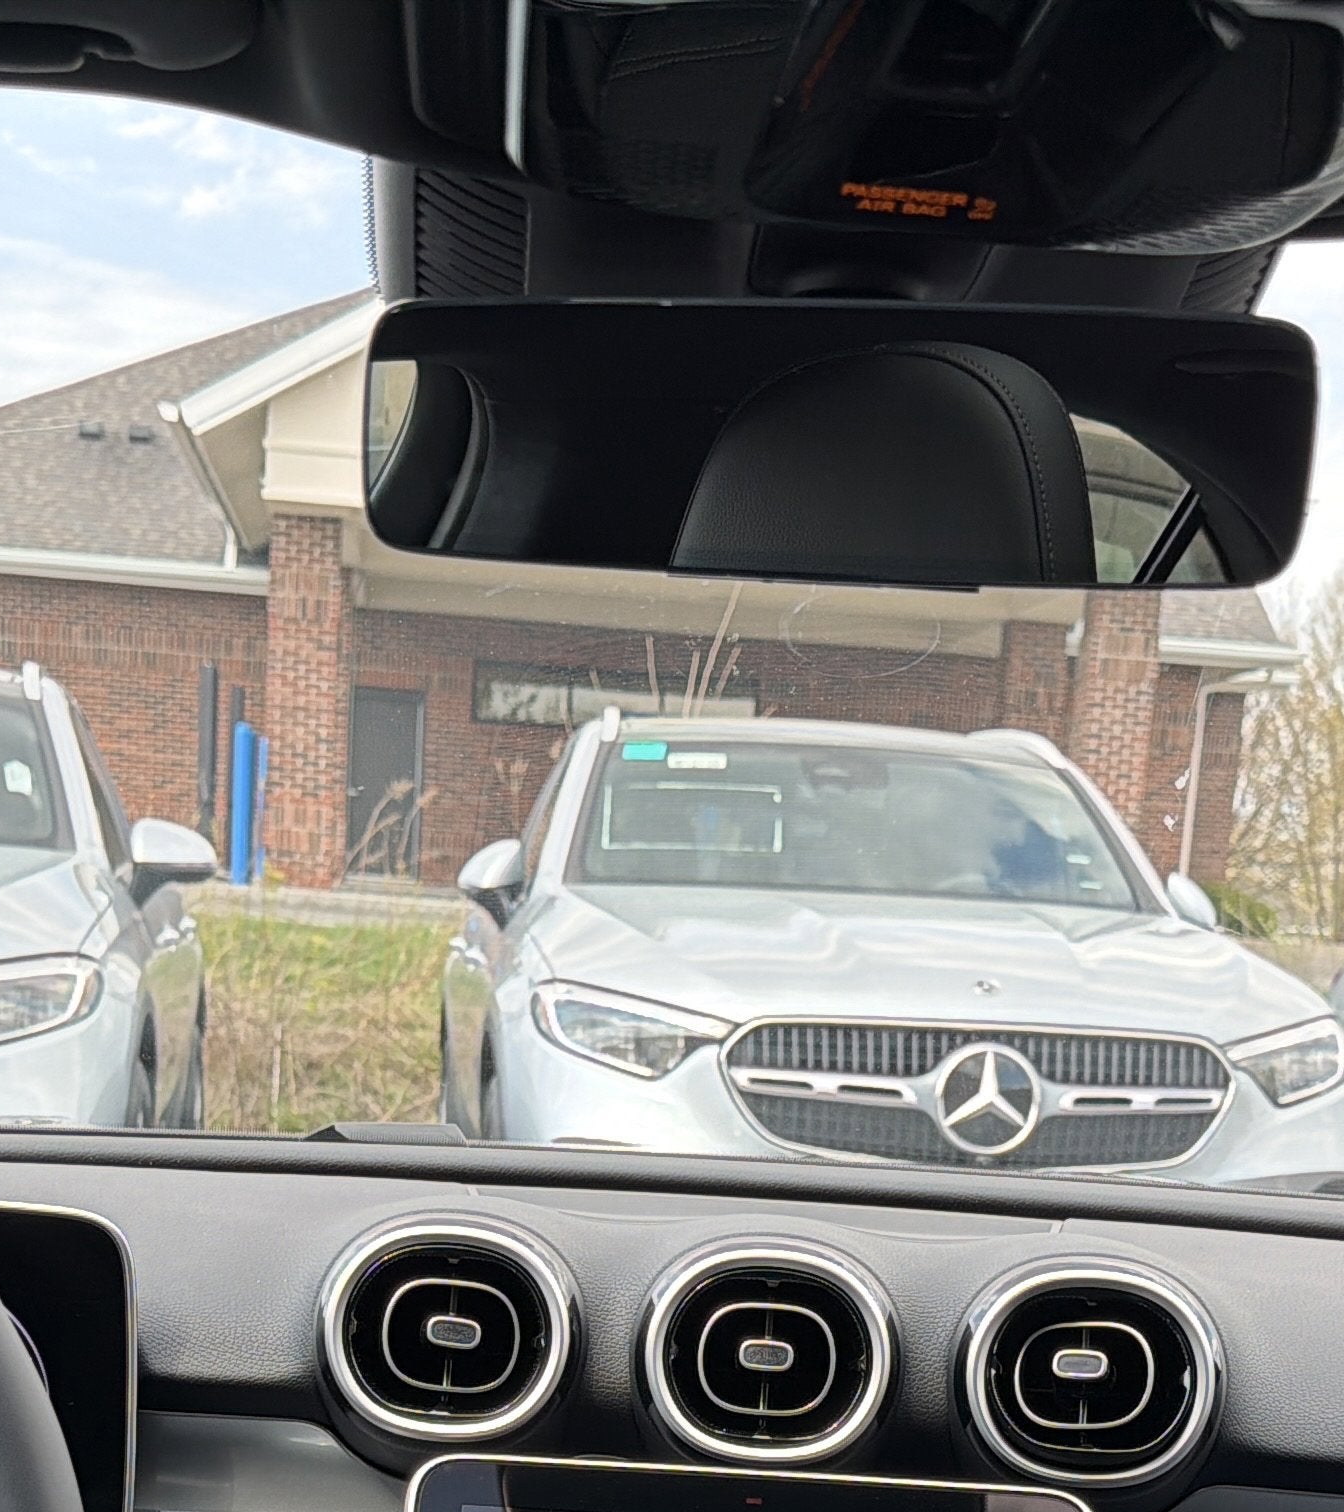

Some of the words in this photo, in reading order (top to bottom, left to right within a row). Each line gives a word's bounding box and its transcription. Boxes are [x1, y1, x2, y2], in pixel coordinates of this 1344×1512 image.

[840, 182, 969, 207] PASSENGER
[856, 199, 896, 213] AIR
[902, 201, 948, 217] BAG
